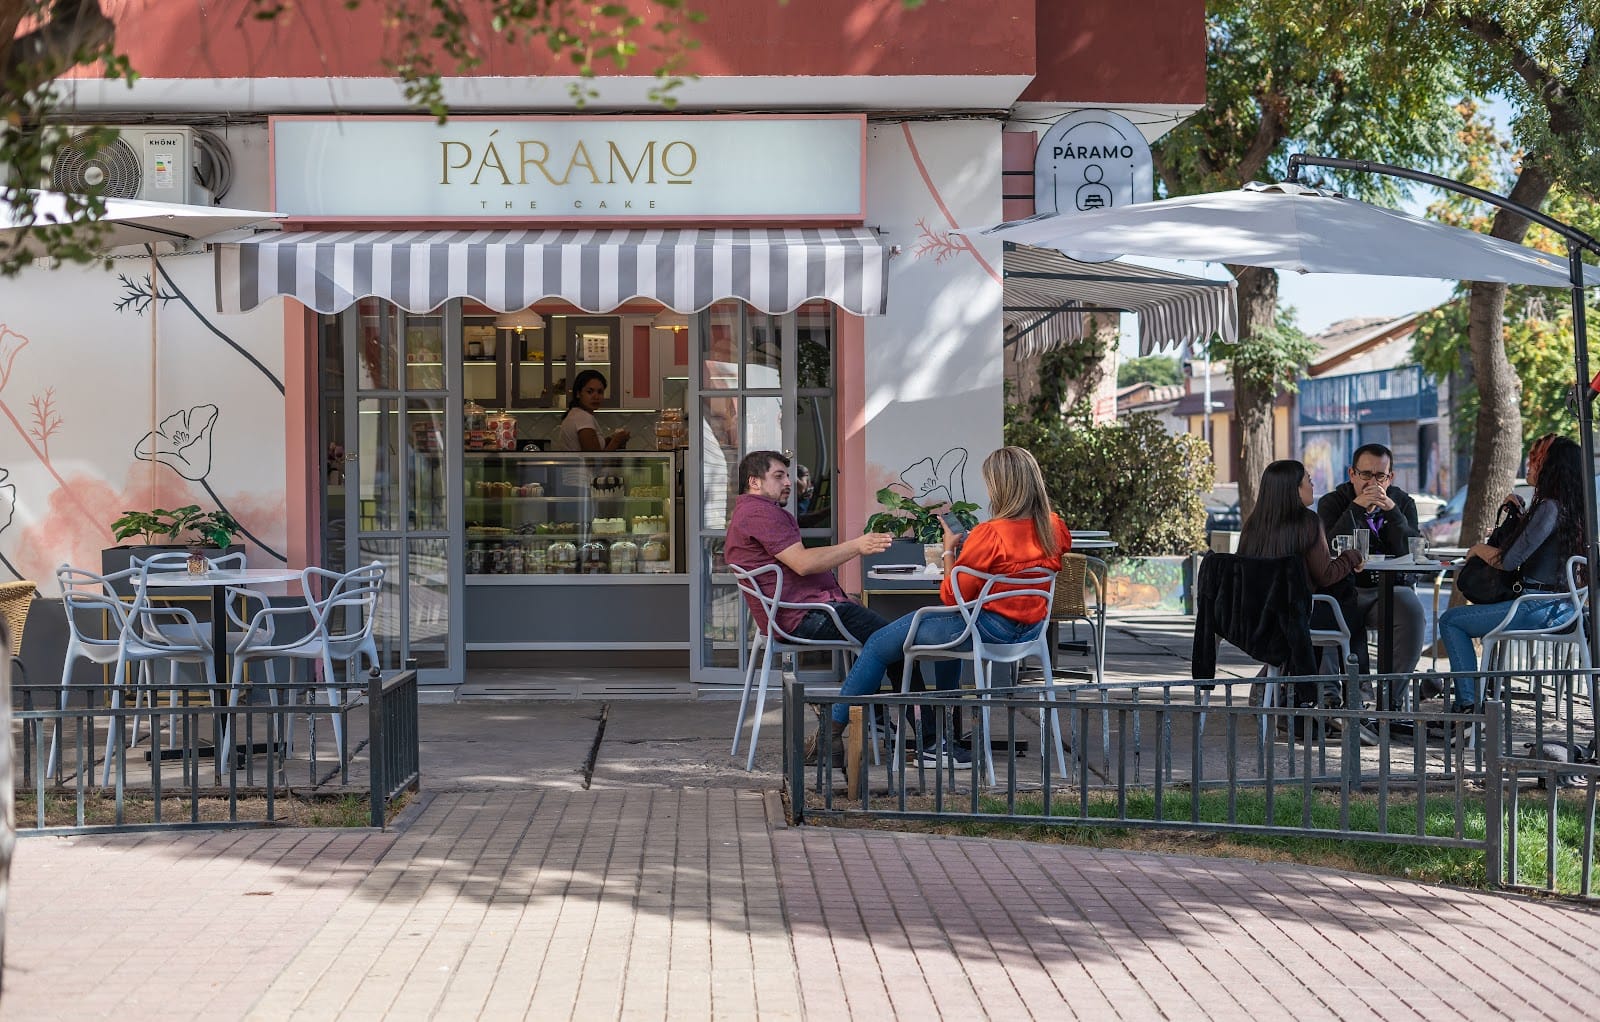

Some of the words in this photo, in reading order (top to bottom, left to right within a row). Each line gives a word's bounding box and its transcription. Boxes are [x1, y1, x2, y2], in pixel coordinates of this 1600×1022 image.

[439, 129, 697, 186] PÁRAMO
[1053, 142, 1133, 160] PÁRAMO
[480, 200, 537, 209] THE
[574, 200, 655, 209] CAKE
